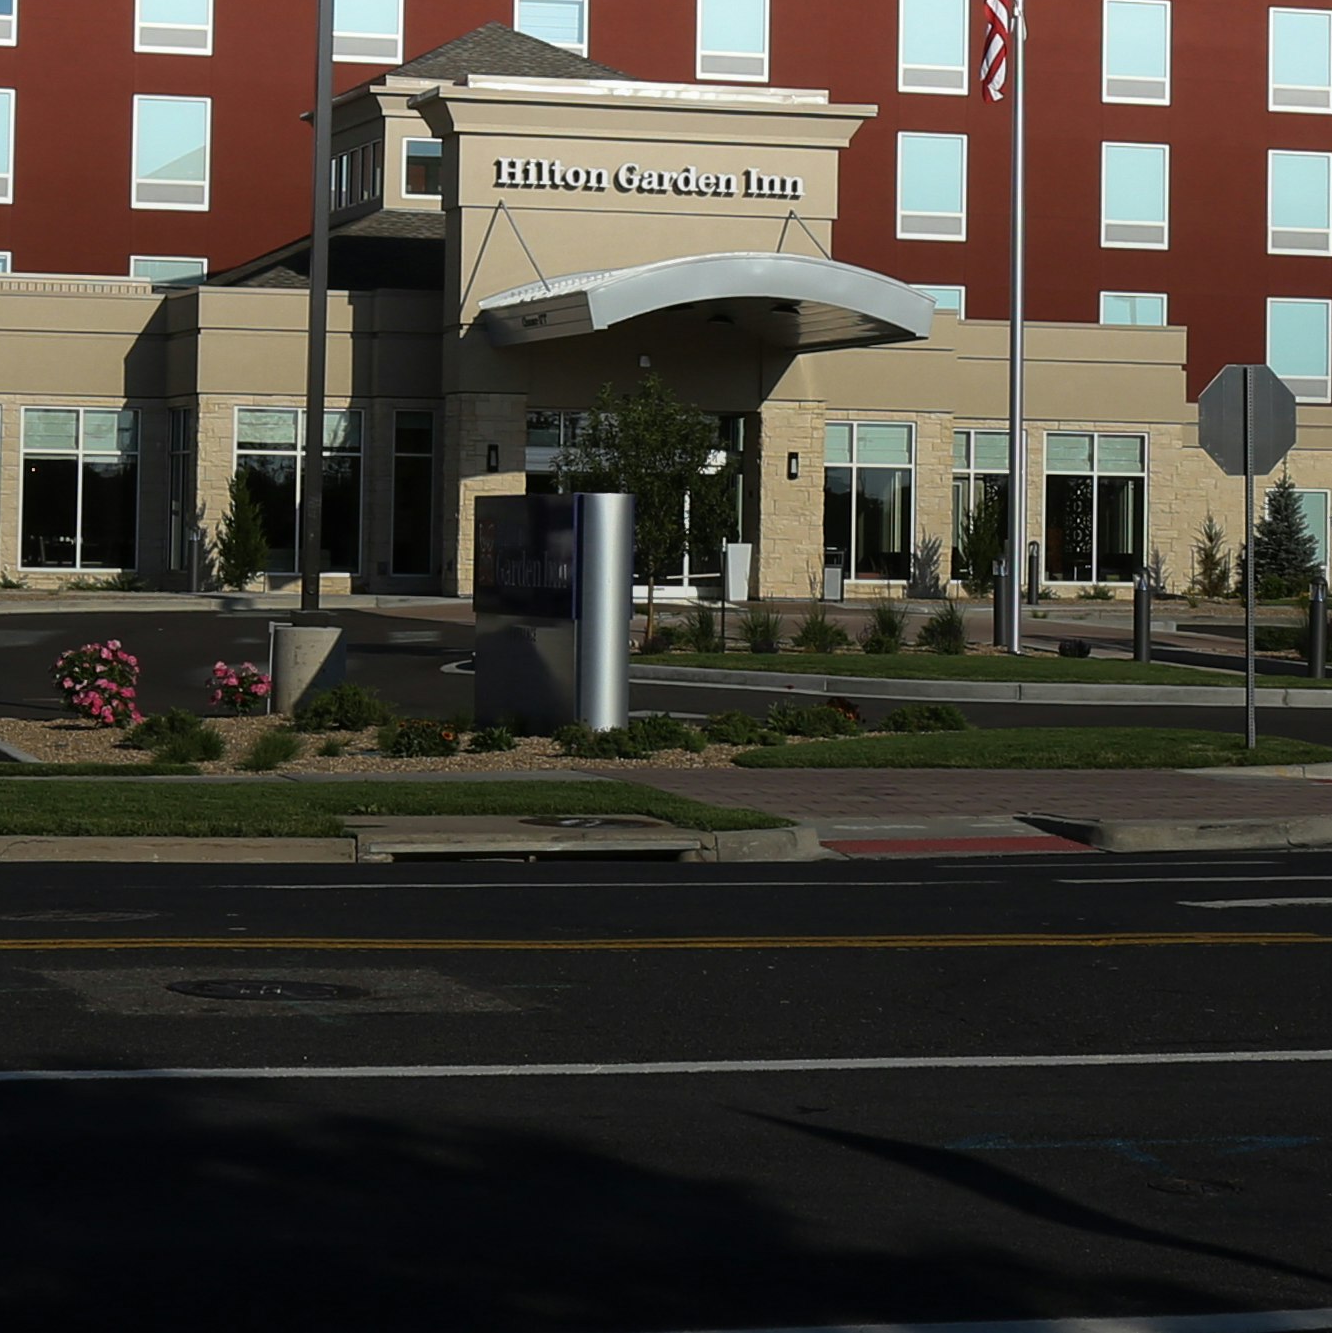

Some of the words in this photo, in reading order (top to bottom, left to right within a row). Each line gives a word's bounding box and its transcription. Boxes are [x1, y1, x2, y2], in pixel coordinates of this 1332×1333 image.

[495, 157, 609, 191] Hilton
[617, 163, 740, 197] Garden
[746, 167, 805, 199] Inn
